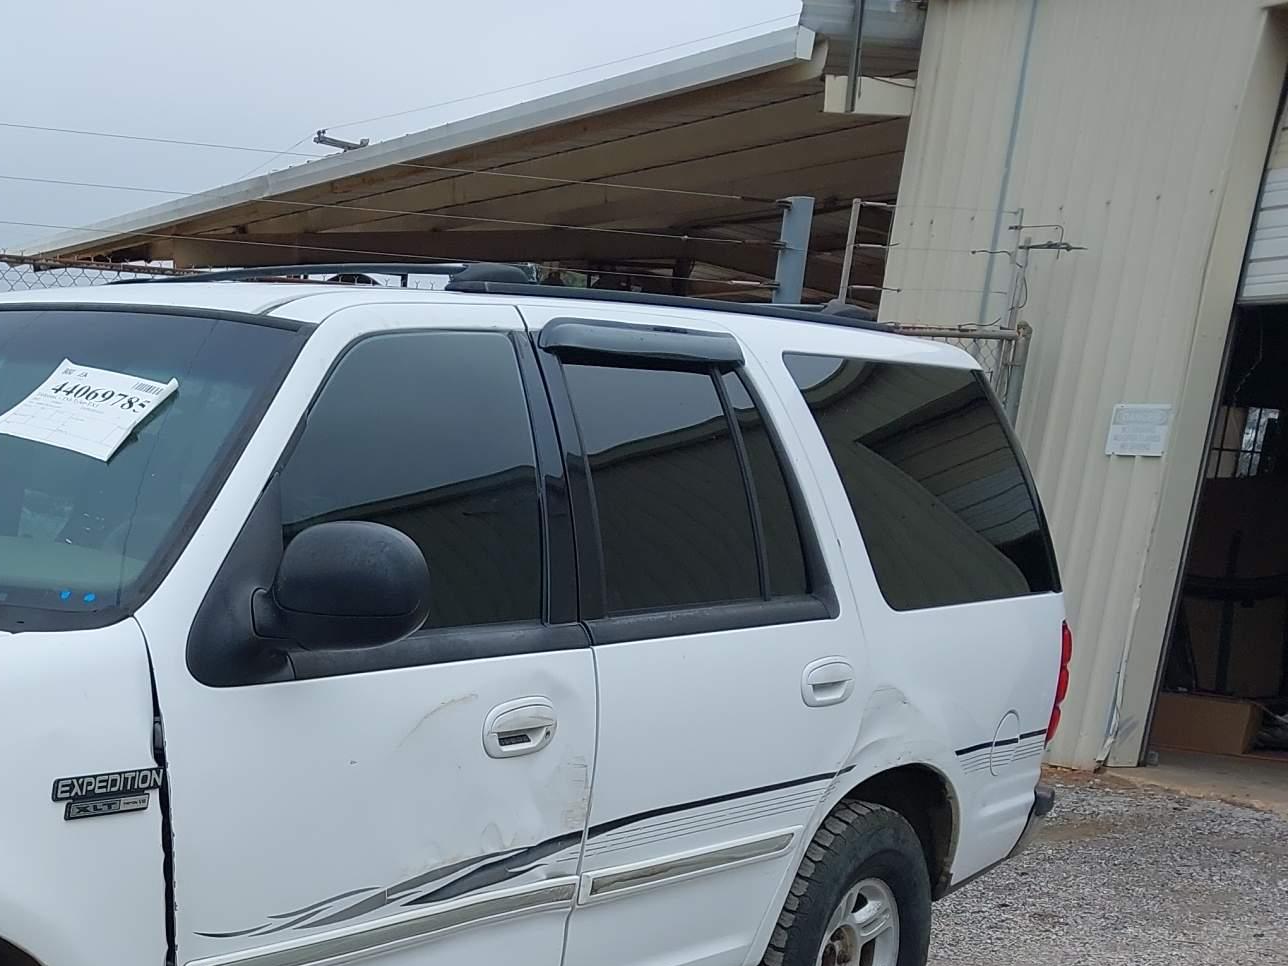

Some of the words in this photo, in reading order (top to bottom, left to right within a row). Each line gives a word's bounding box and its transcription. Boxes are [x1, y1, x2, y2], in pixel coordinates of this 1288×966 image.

[52, 381, 152, 413] 44069785
[57, 769, 164, 798] EXPEDITION
[74, 801, 117, 815] XLT
